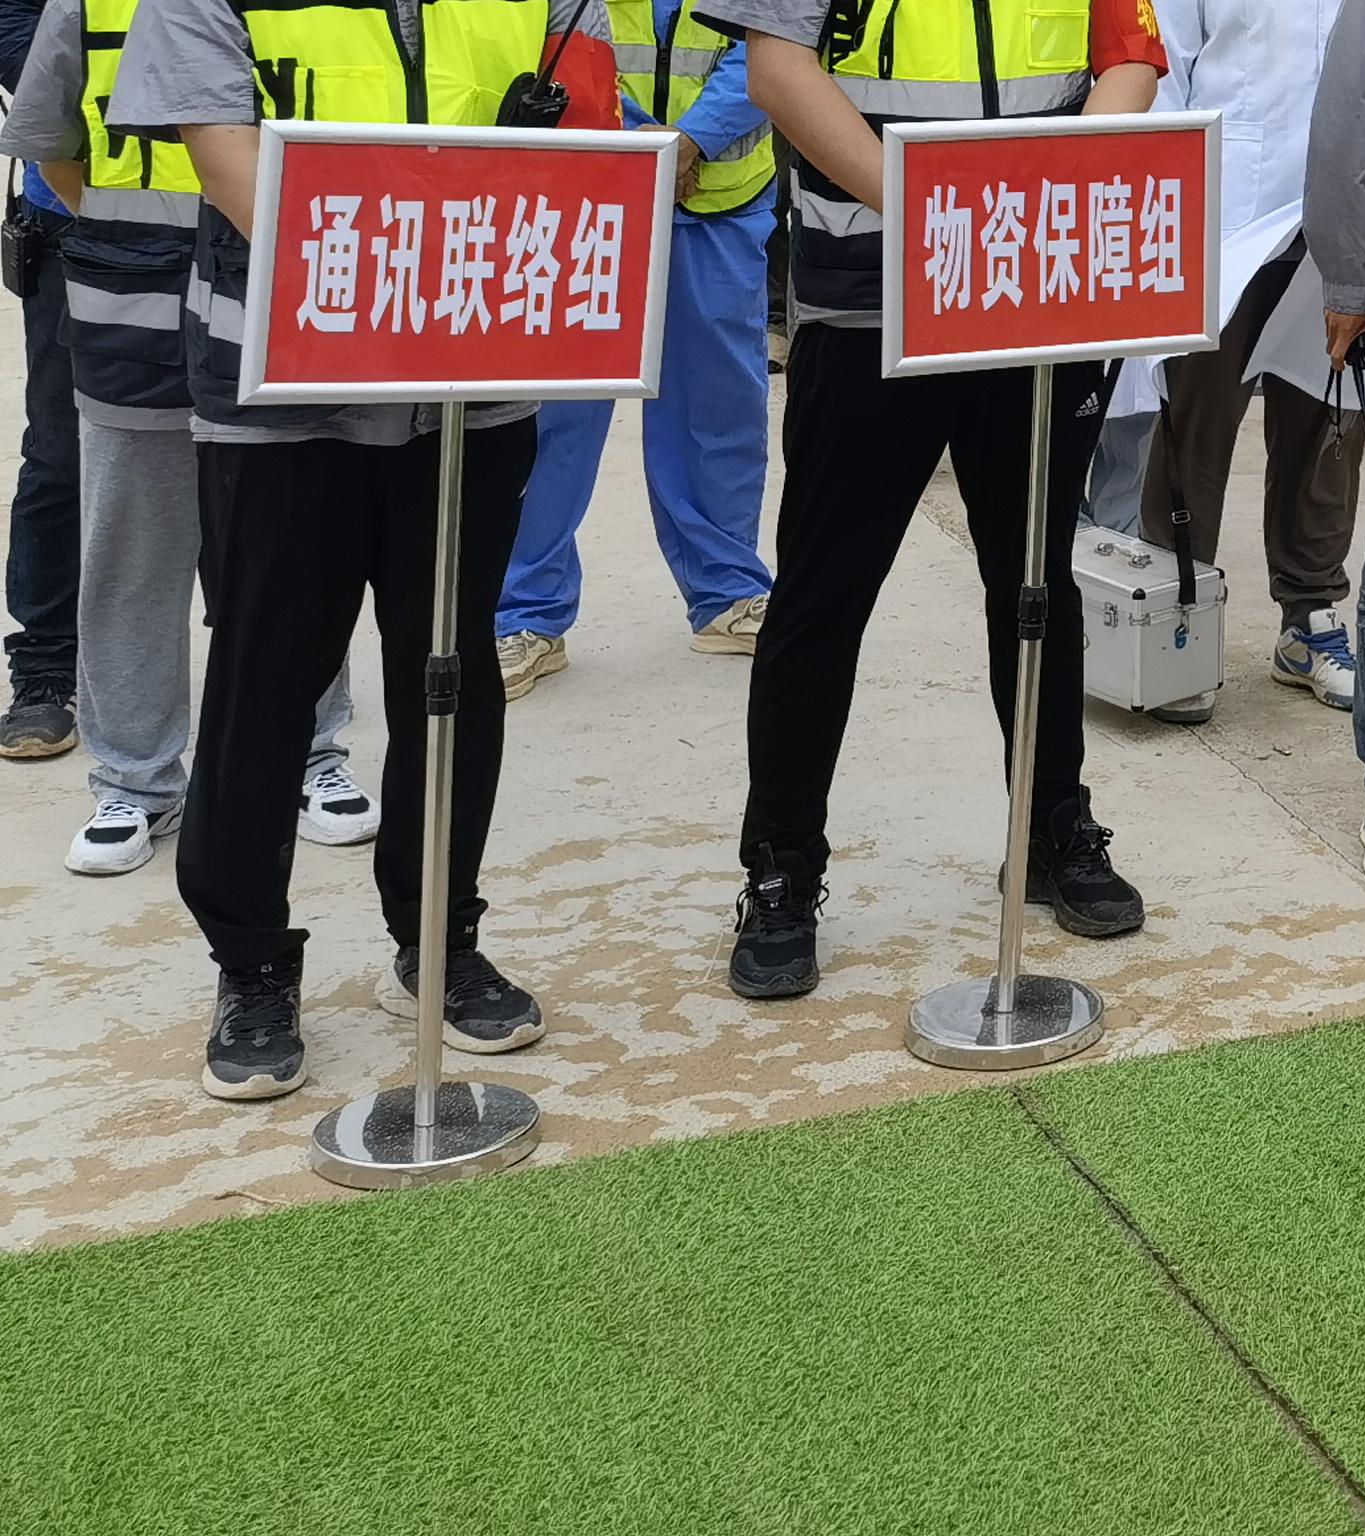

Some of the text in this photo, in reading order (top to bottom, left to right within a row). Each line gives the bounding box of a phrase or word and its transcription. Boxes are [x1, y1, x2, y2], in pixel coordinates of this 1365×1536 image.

[296, 192, 625, 336] 通讯联络组
[923, 174, 1185, 316] 物资保障组
